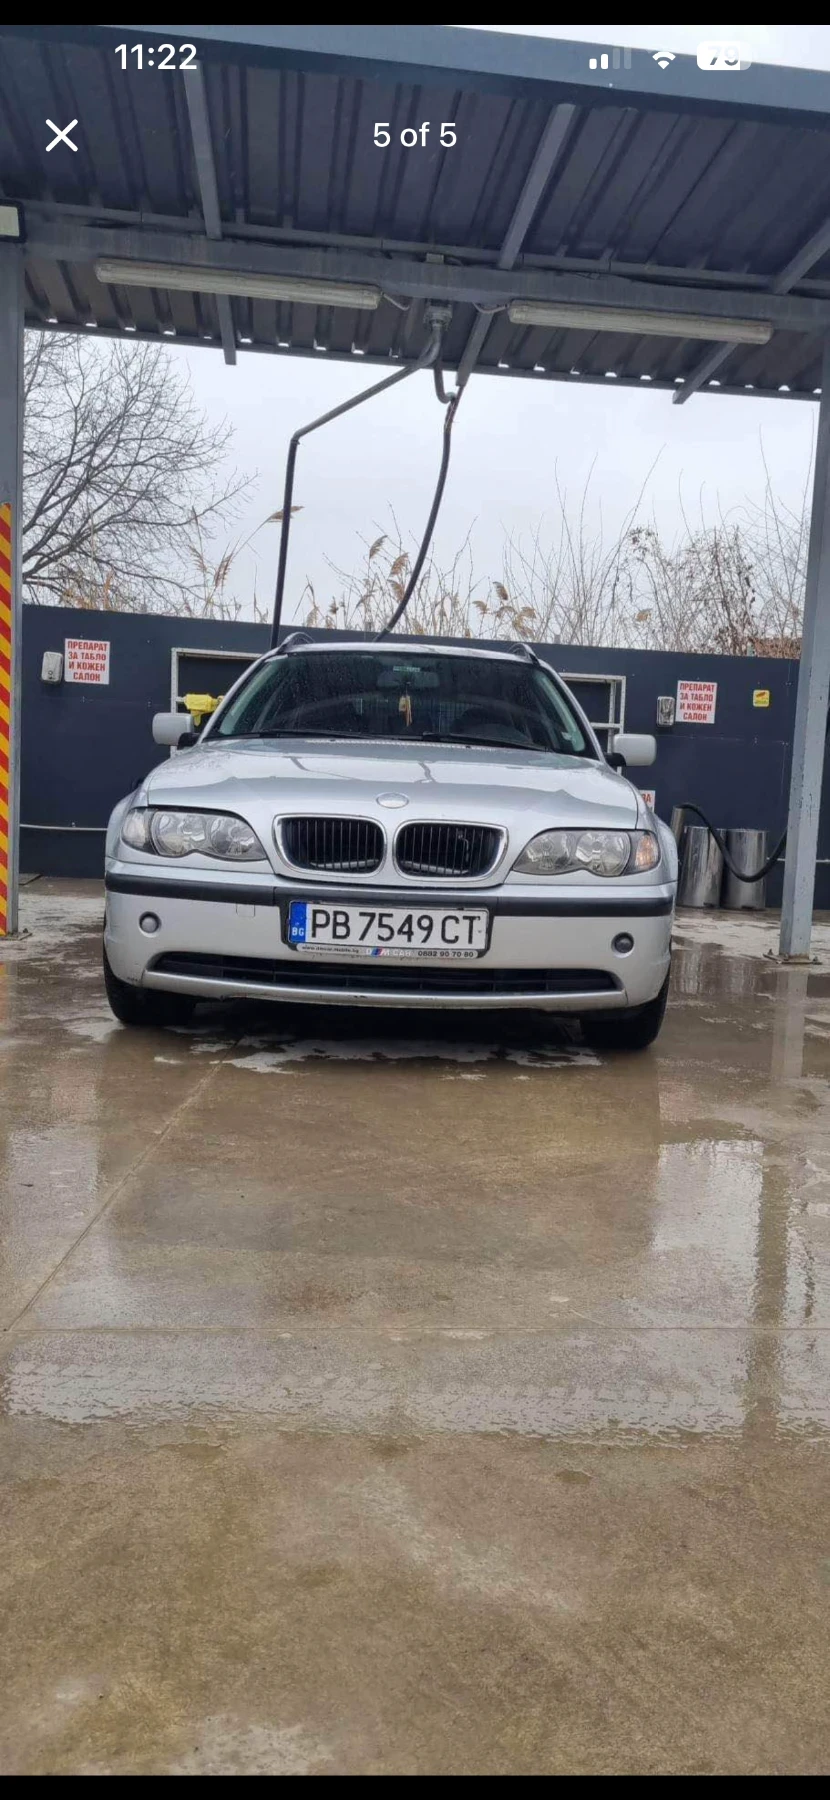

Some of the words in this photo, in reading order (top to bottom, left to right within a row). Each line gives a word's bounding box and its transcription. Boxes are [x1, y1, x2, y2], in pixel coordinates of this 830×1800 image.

[67, 640, 107, 651] ПРЕПАРАТ
[68, 651, 78, 660] ЗА
[81, 652, 106, 661] ТАБЛО
[69, 661, 74, 669] И
[77, 661, 105, 671] КОЖЕН
[73, 672, 101, 681] САЛОН
[680, 683, 714, 692] ПРЕПАРАТ
[680, 692, 688, 700] ЗА
[691, 693, 713, 702] ТАБЛО
[687, 703, 712, 711] КОЖЕН
[683, 712, 707, 721] САЛОН
[311, 909, 351, 939] PB
[358, 911, 434, 943] 7549
[441, 914, 481, 944] CT
[291, 927, 305, 937] BG
[440, 950, 451, 958] 90
